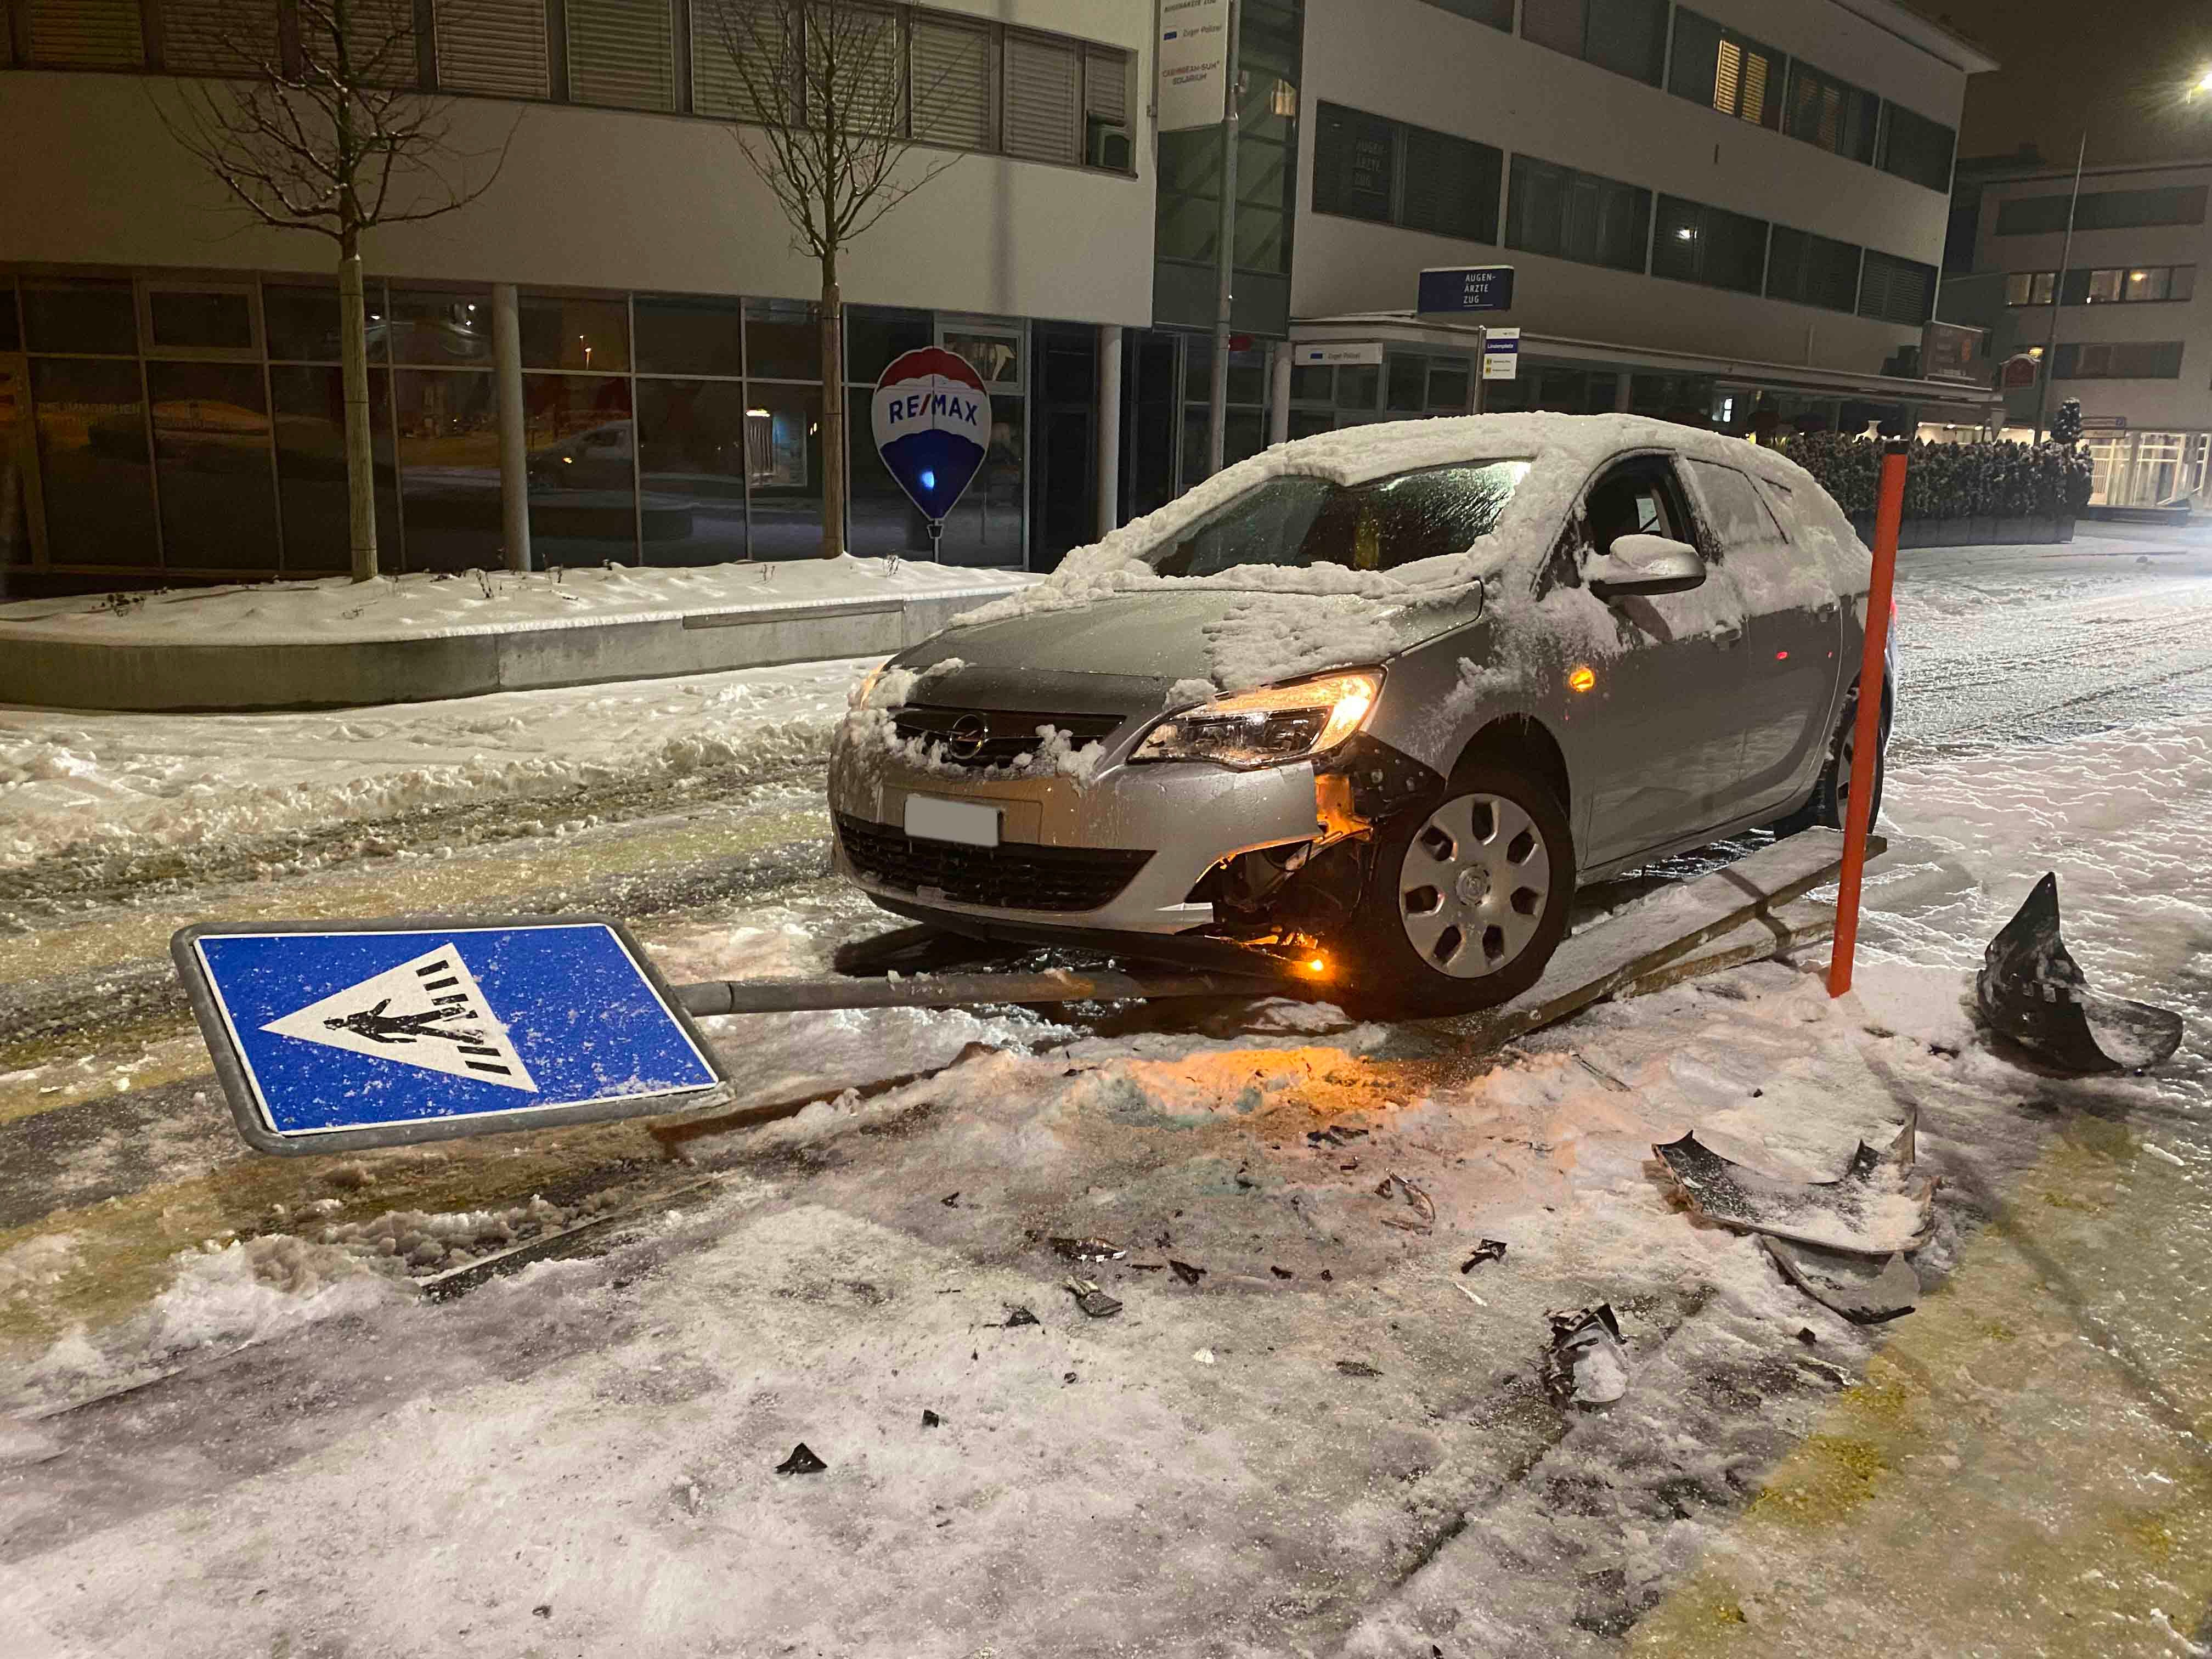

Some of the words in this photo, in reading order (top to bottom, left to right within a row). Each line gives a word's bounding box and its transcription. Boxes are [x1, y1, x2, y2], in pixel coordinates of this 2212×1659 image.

[1465, 273, 1497, 281] AUGEN-
[1464, 283, 1488, 292] ÄRZTE
[1463, 295, 1479, 303] ZUG
[889, 393, 978, 426] RE/MAX
